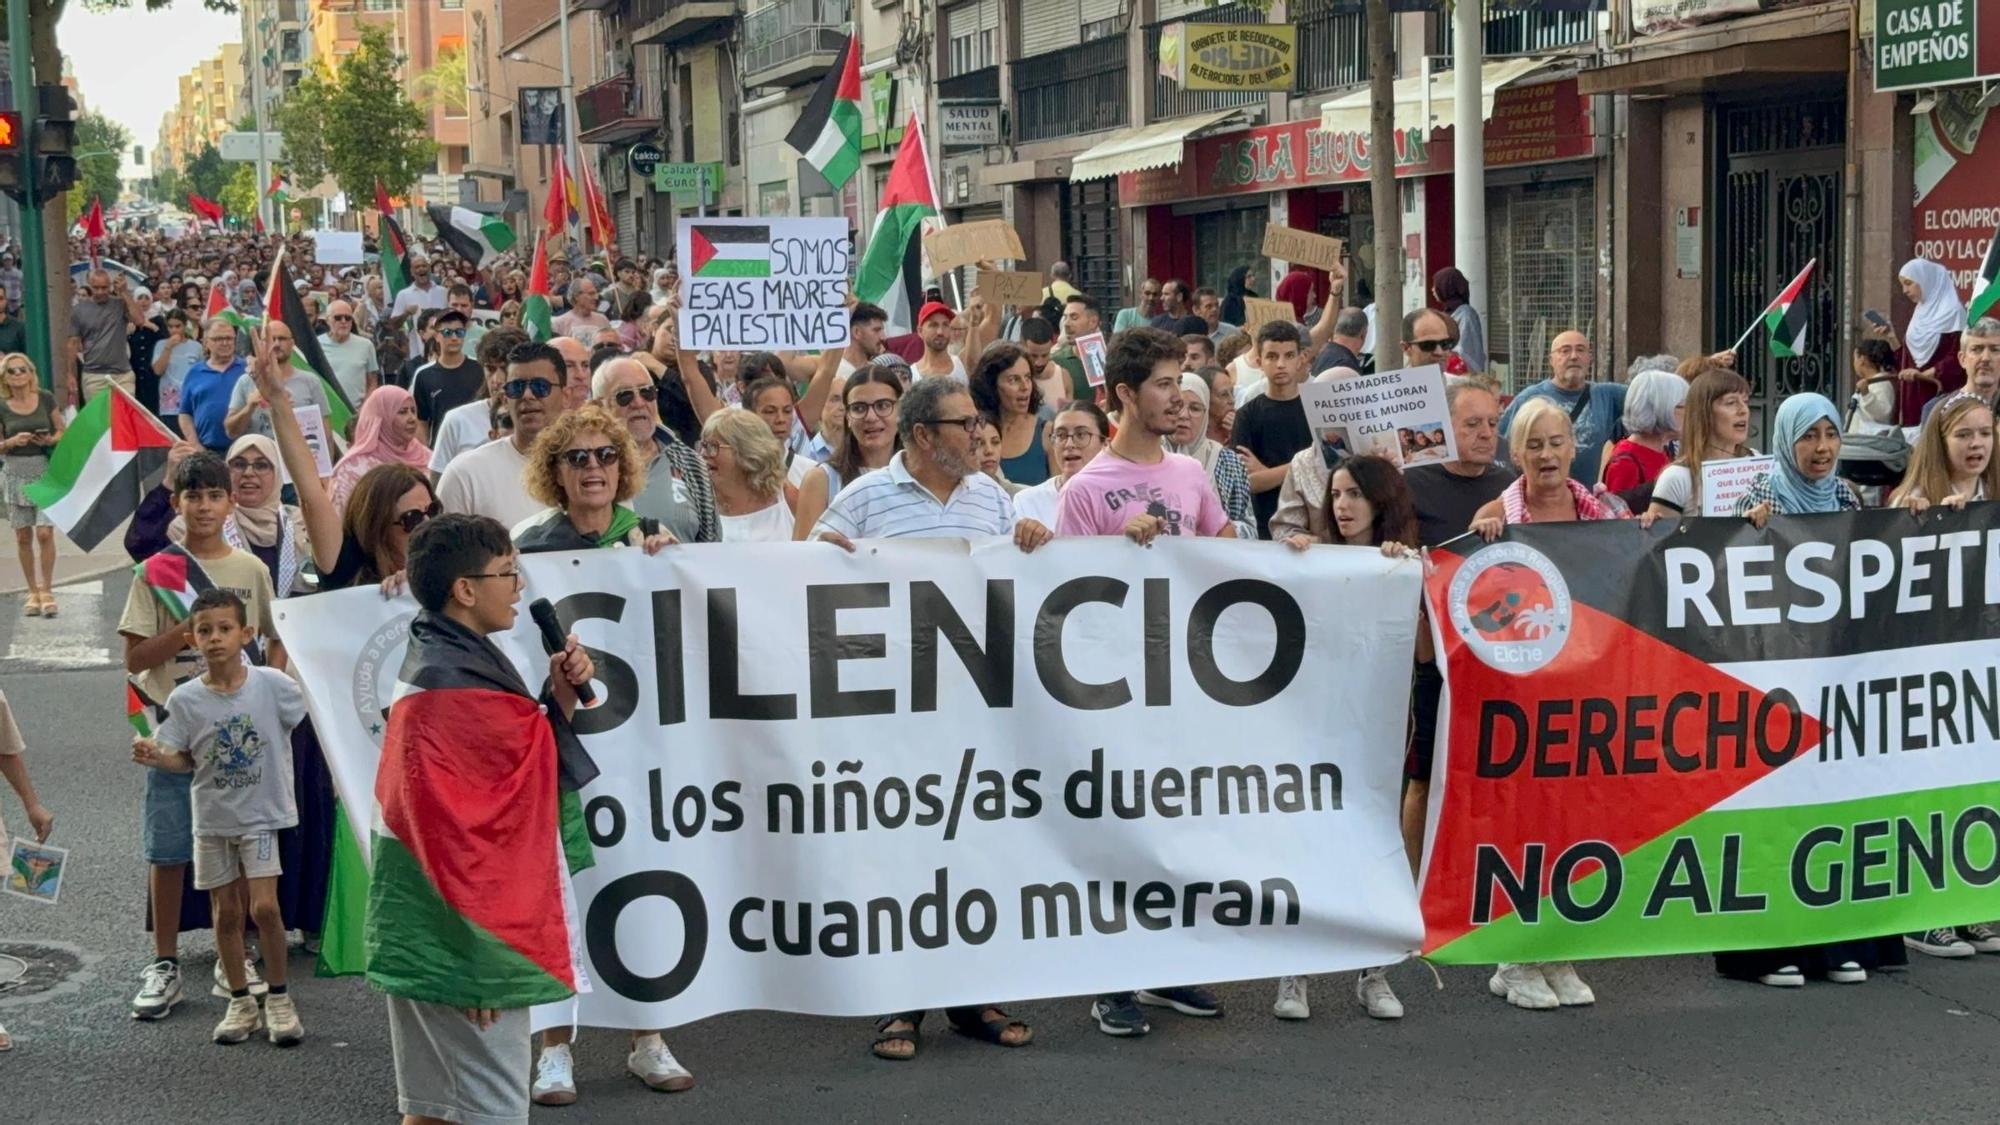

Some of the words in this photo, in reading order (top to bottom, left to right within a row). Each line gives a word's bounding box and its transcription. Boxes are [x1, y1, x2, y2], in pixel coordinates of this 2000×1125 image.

[1886, 4, 1933, 36] CASA
[1938, 0, 1963, 28] DE
[1227, 30, 1238, 42] DE
[1880, 30, 1969, 70] EMPEÑOS
[1248, 73, 1265, 86] DEL
[949, 108, 990, 119] SALUD
[945, 121, 993, 131] MENTAL
[1924, 210, 1940, 230] EL
[771, 237, 848, 276] SOMOS
[1914, 240, 1944, 260] ORO
[1945, 239, 1955, 259] Y
[1957, 239, 1975, 259] LA
[688, 281, 755, 310] ESAS
[763, 279, 849, 310] MADRES
[691, 312, 848, 346] PALESTINAS
[1331, 381, 1352, 393] LAS
[1355, 373, 1402, 390] MADRES
[1314, 393, 1379, 409] PALESTINAS
[1381, 385, 1428, 400] LLORAN
[1322, 414, 1337, 424] LO
[1339, 411, 1362, 423] QUE
[1365, 409, 1378, 419] EL
[1380, 400, 1426, 417] MUNDO
[1358, 421, 1394, 435] CALLA
[1736, 463, 1770, 473] EXPLICO
[1716, 480, 1733, 488] QUE
[541, 575, 1306, 735] SILENCIO
[1493, 645, 1543, 663] Elche
[359, 661, 374, 713] Ayuda
[367, 648, 380, 660] a
[1475, 687, 1802, 779] DERECHO
[1818, 666, 2000, 763] INTERN
[648, 767, 744, 842] los
[767, 748, 1042, 840] niños/as
[1064, 747, 1343, 821] duerman
[1470, 839, 1624, 925] NO
[1640, 833, 1768, 919] AL
[1789, 804, 2000, 908] GENO
[729, 866, 997, 958] cuando
[1021, 877, 1300, 940] mueran
